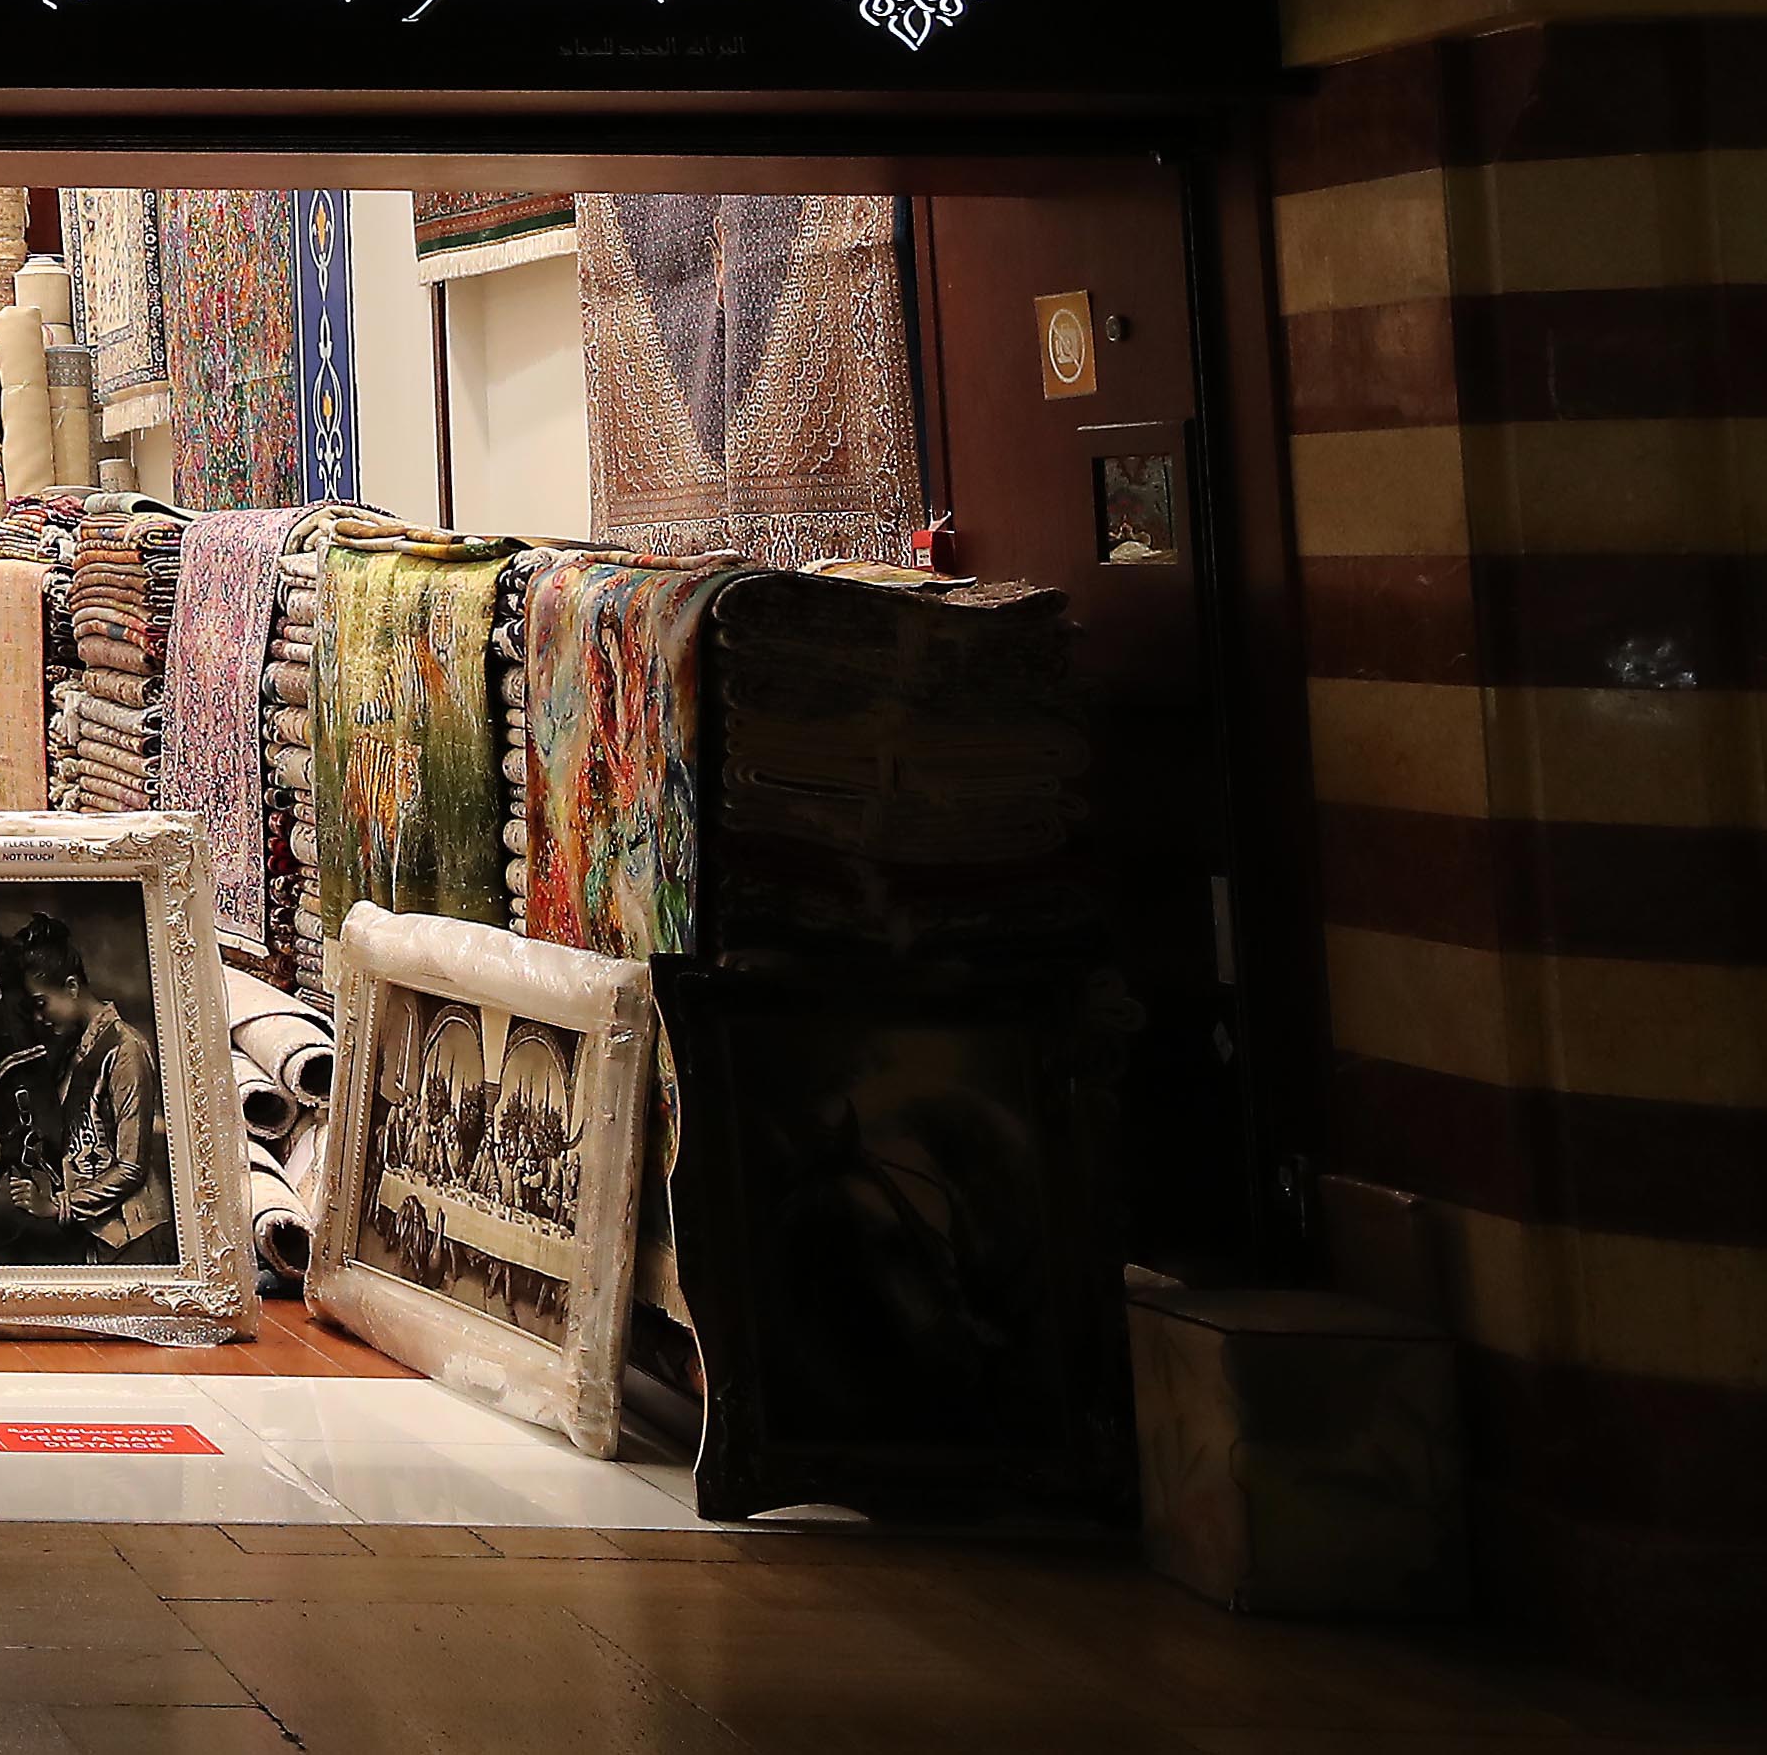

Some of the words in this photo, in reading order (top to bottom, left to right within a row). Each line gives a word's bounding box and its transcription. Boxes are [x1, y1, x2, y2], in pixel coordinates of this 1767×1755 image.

[3, 840, 35, 848] PLEASE
[39, 840, 53, 848] DO
[2, 853, 22, 861] NOT
[23, 853, 54, 861] TOUCH
[43, 1441, 165, 1449] DISTANCE
